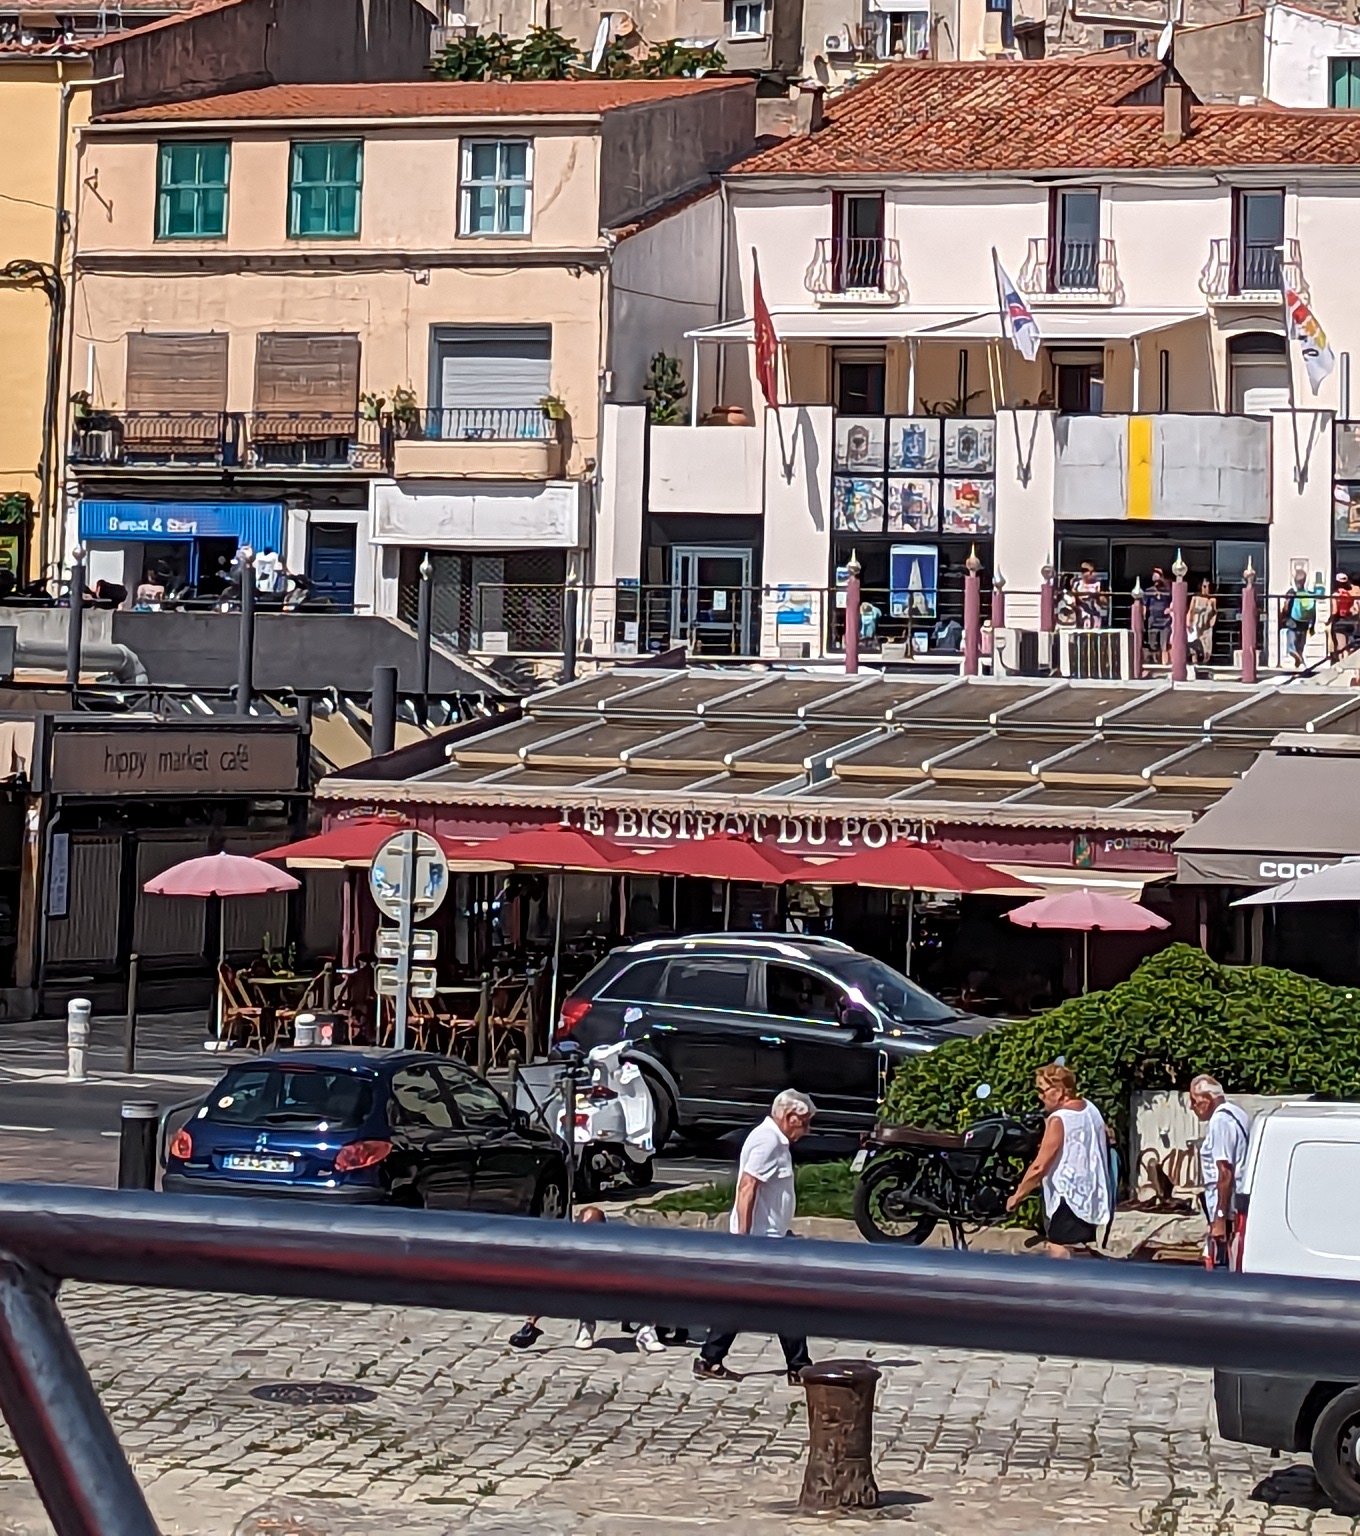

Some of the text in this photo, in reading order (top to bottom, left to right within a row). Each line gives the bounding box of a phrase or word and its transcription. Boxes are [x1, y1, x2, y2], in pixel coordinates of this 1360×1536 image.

[158, 744, 209, 773] market
[219, 744, 249, 772] café
[614, 809, 768, 843] BISTROT
[776, 814, 828, 846] DU
[838, 816, 936, 848] PORT
